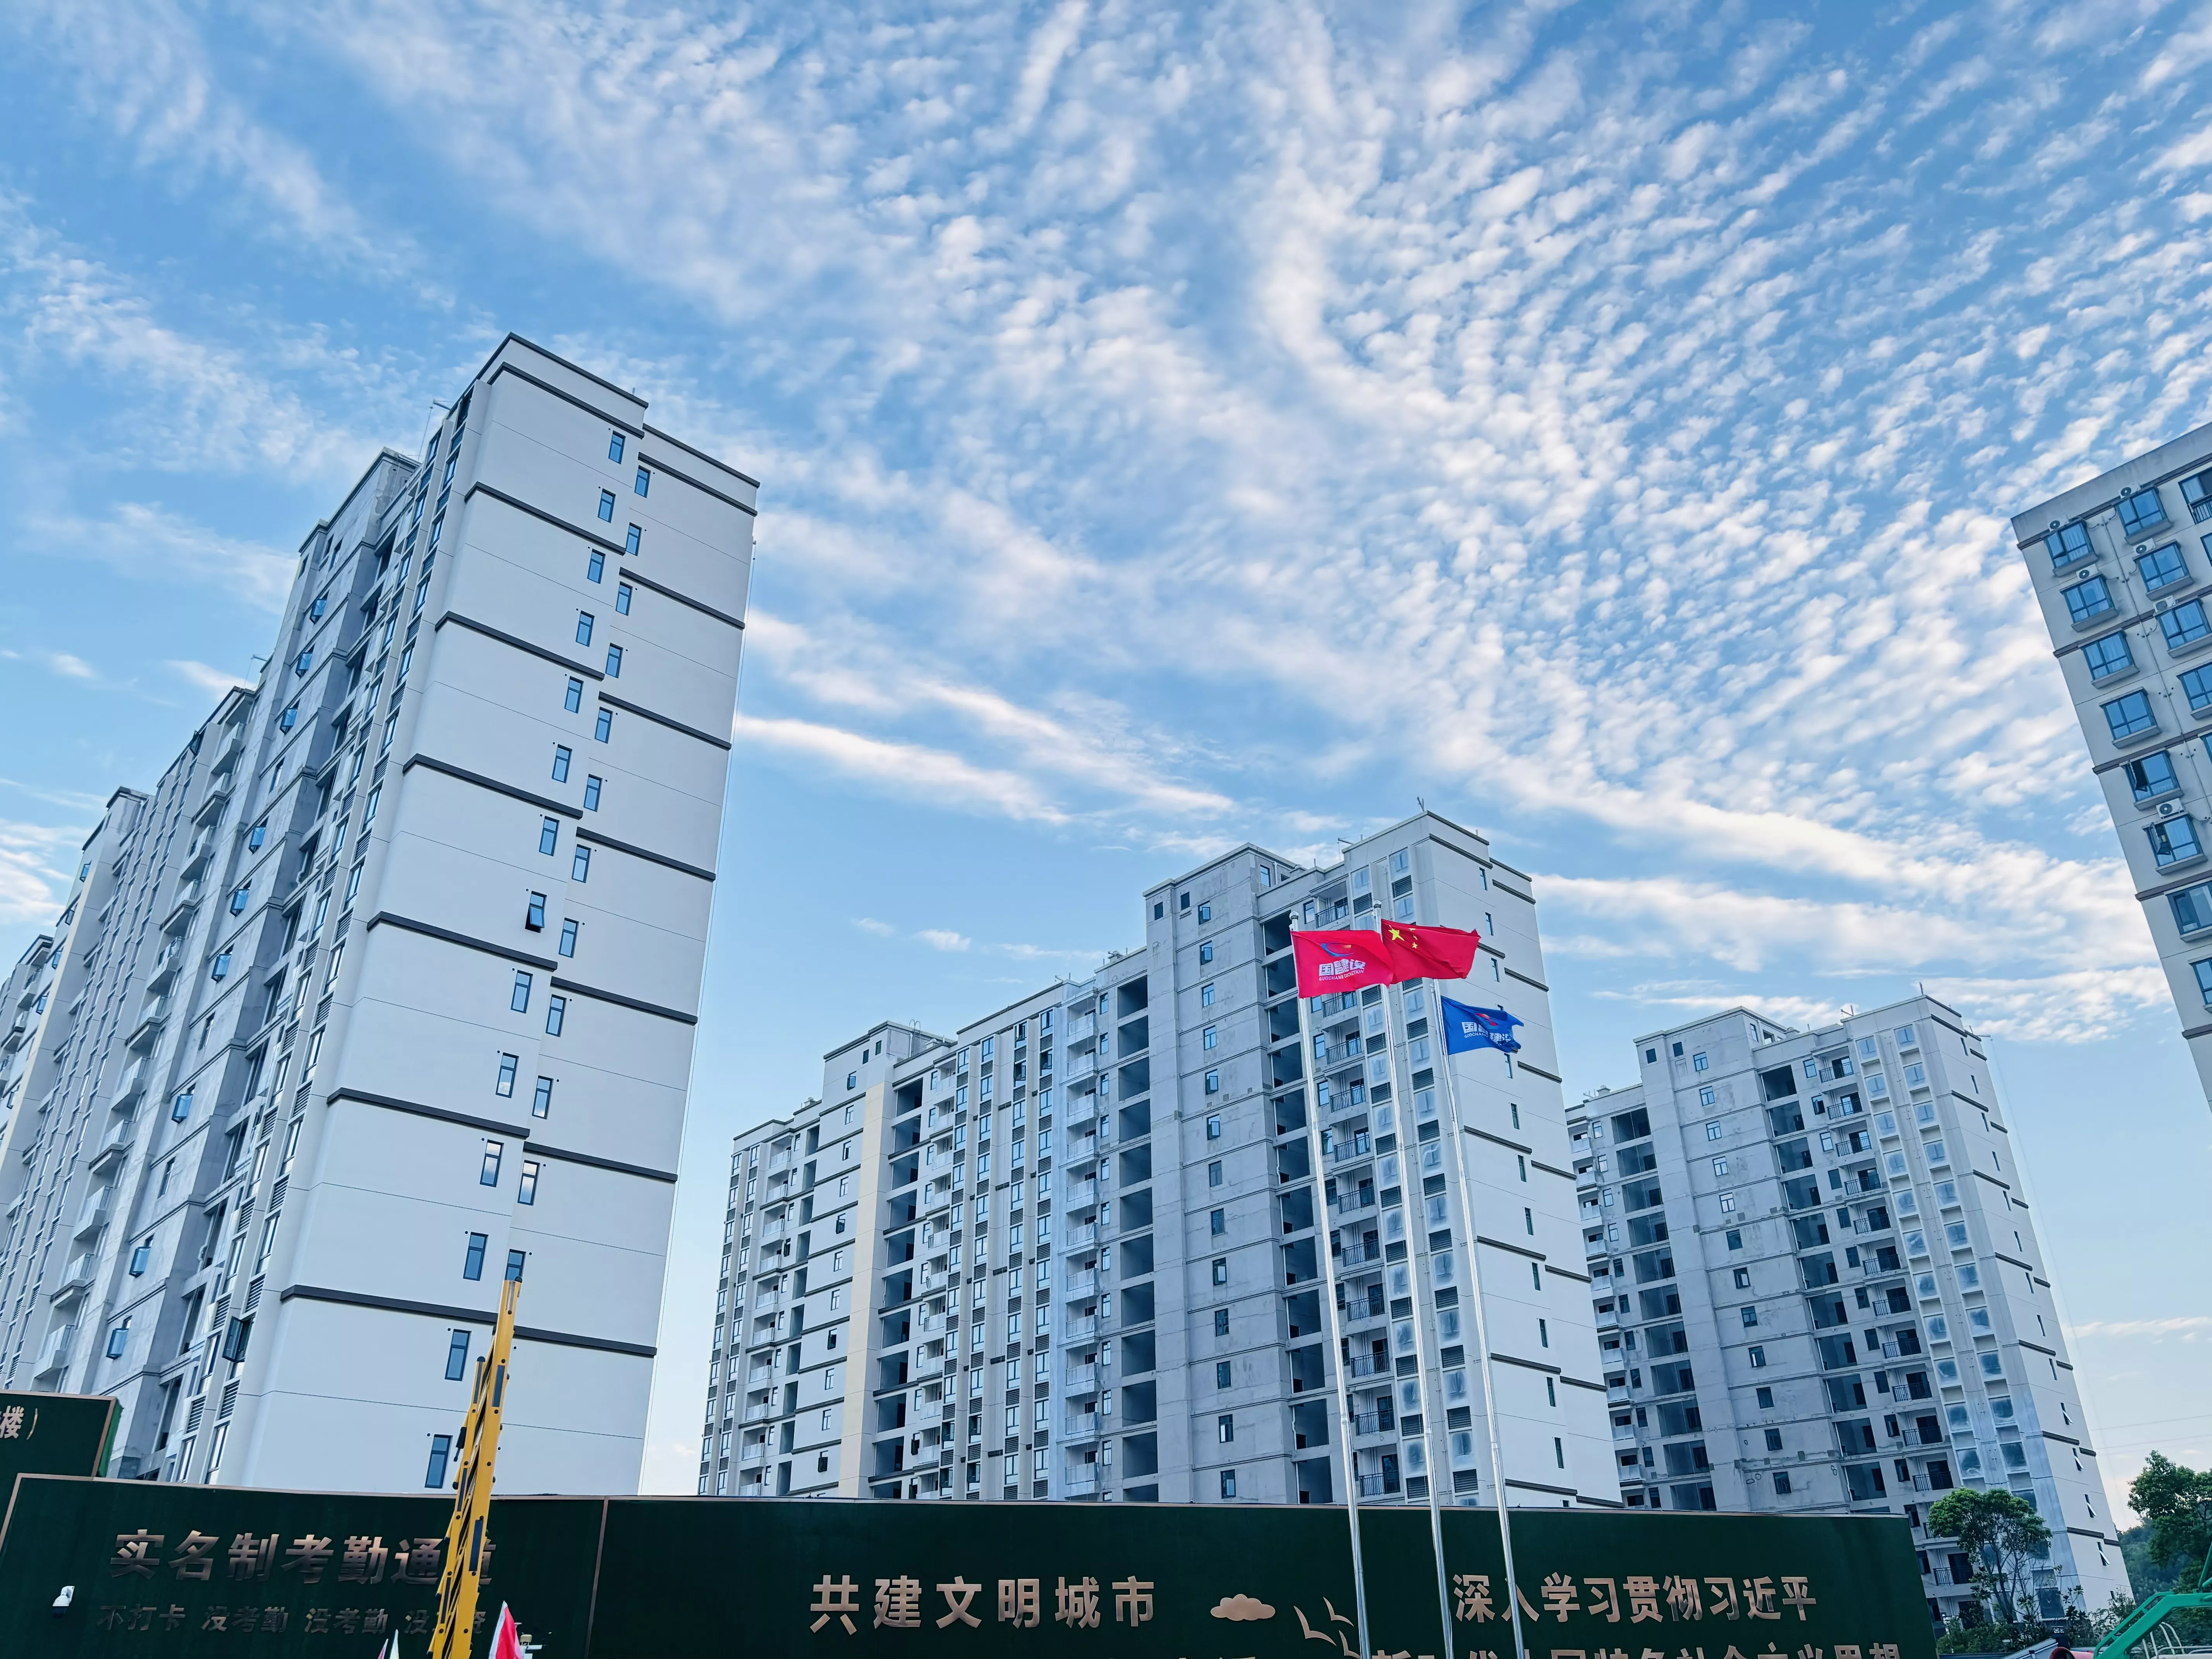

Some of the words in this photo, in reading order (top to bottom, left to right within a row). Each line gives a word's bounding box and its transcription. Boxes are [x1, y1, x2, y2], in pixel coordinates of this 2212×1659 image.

[98, 1604, 185, 1631] 不打卡
[201, 1606, 289, 1633] 没考勤
[304, 1607, 388, 1634] 没考勤
[810, 1575, 1154, 1635] 共建文明城市
